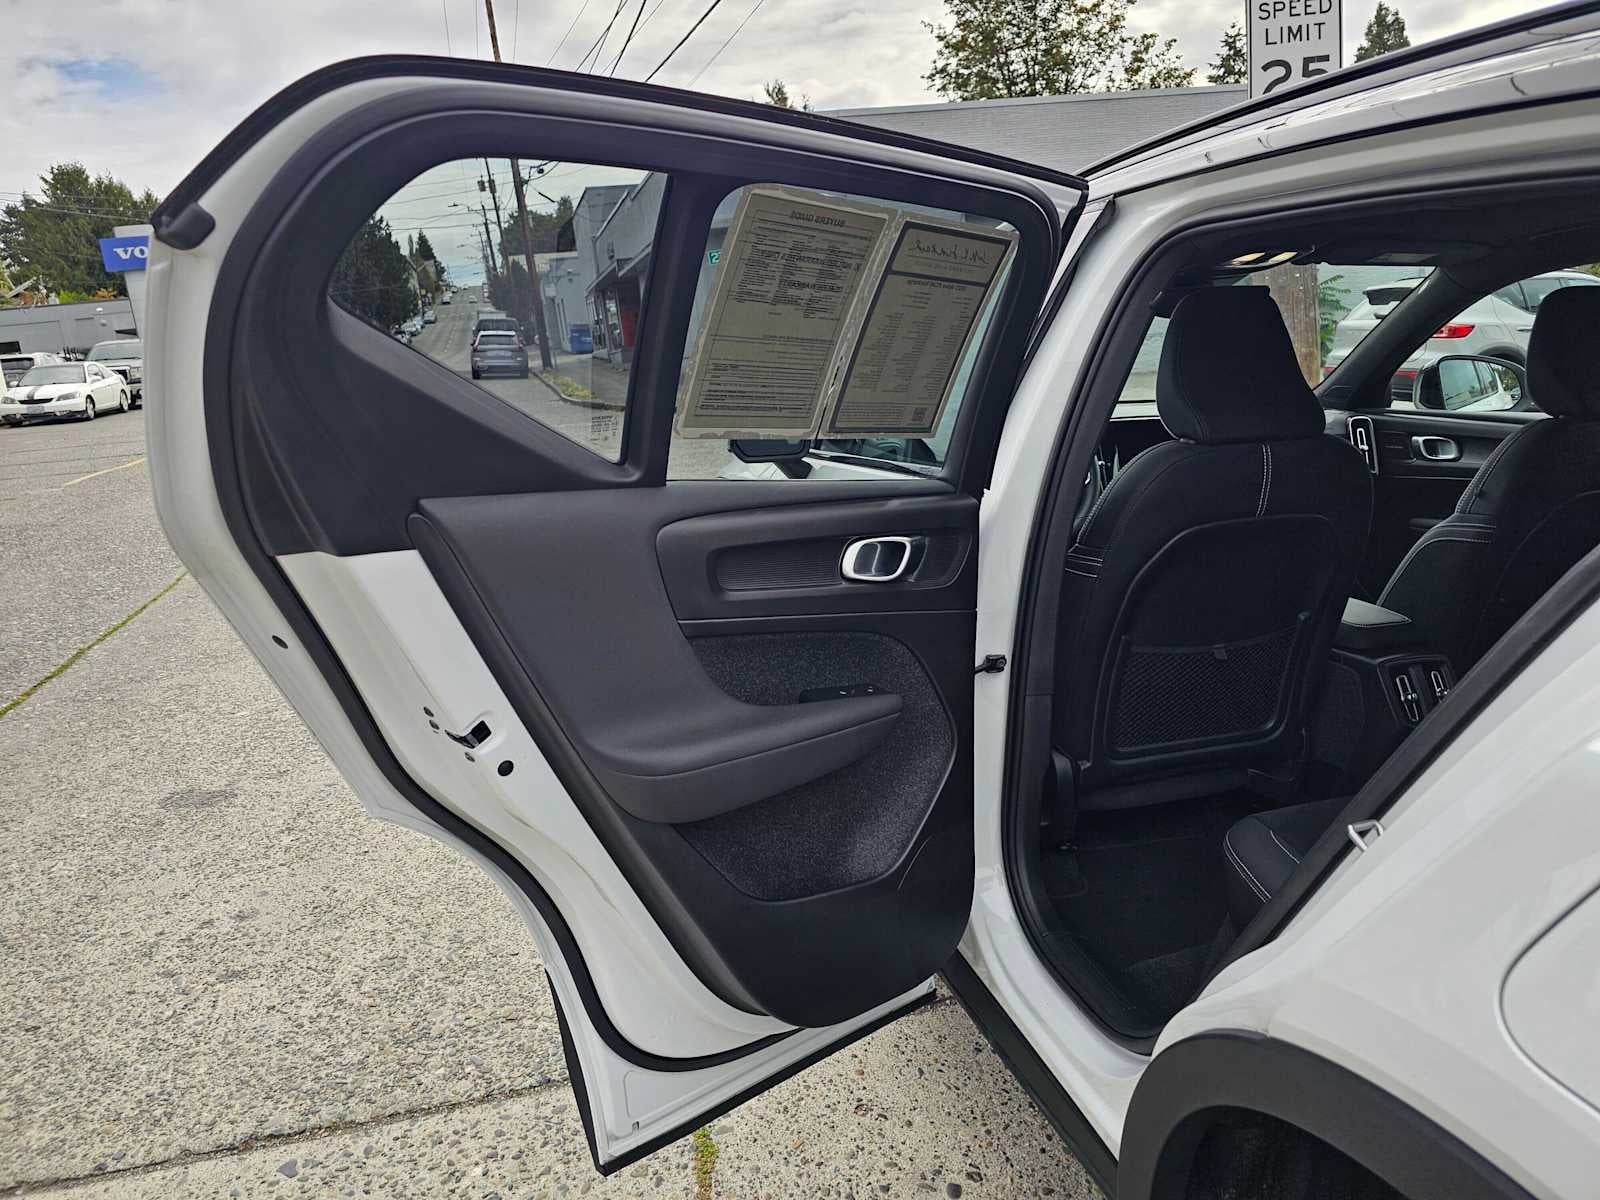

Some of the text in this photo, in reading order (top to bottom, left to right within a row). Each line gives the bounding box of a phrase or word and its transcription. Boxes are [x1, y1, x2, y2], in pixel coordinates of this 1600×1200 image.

[1258, 0, 1332, 20] SPEED
[1265, 22, 1326, 46] LIMIT
[1261, 54, 1330, 95] 25
